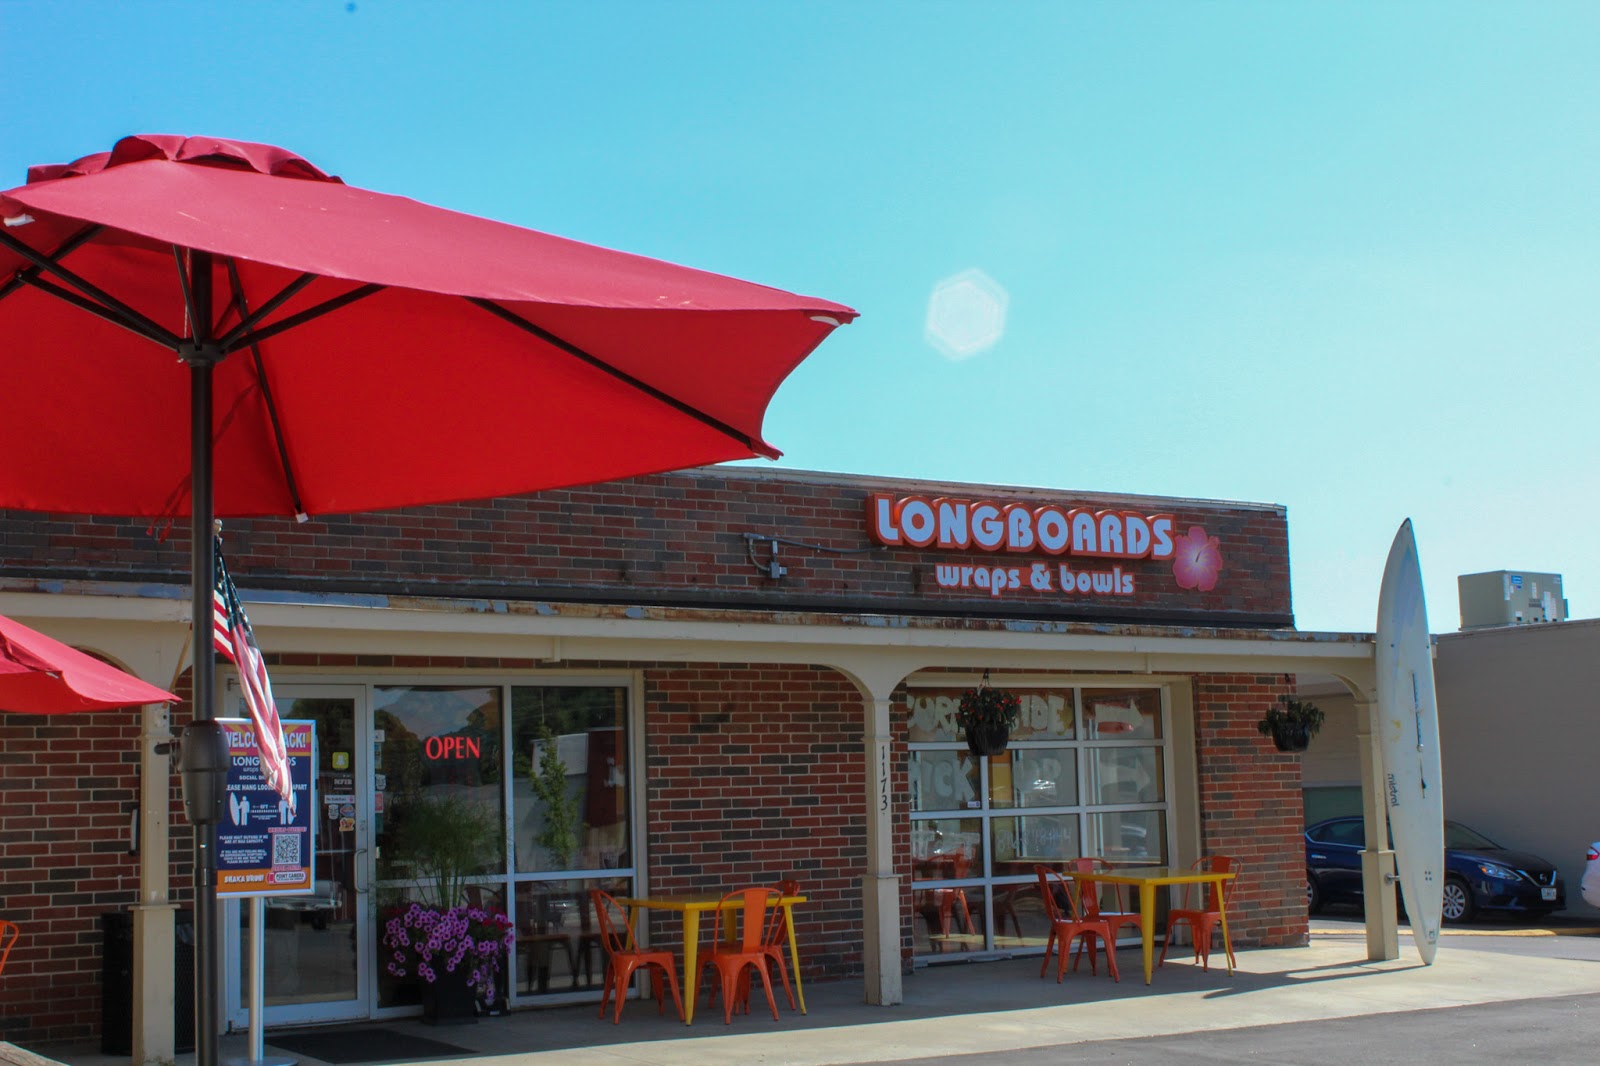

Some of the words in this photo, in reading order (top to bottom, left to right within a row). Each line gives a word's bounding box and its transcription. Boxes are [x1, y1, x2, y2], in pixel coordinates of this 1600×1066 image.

[876, 496, 1175, 558] LONGBOARDS
[935, 564, 1022, 597] wraps
[1029, 562, 1053, 593] &
[1059, 564, 1135, 595] bowls
[285, 732, 306, 748] ACK!
[425, 735, 481, 761] OPEN
[227, 783, 241, 791] EASE
